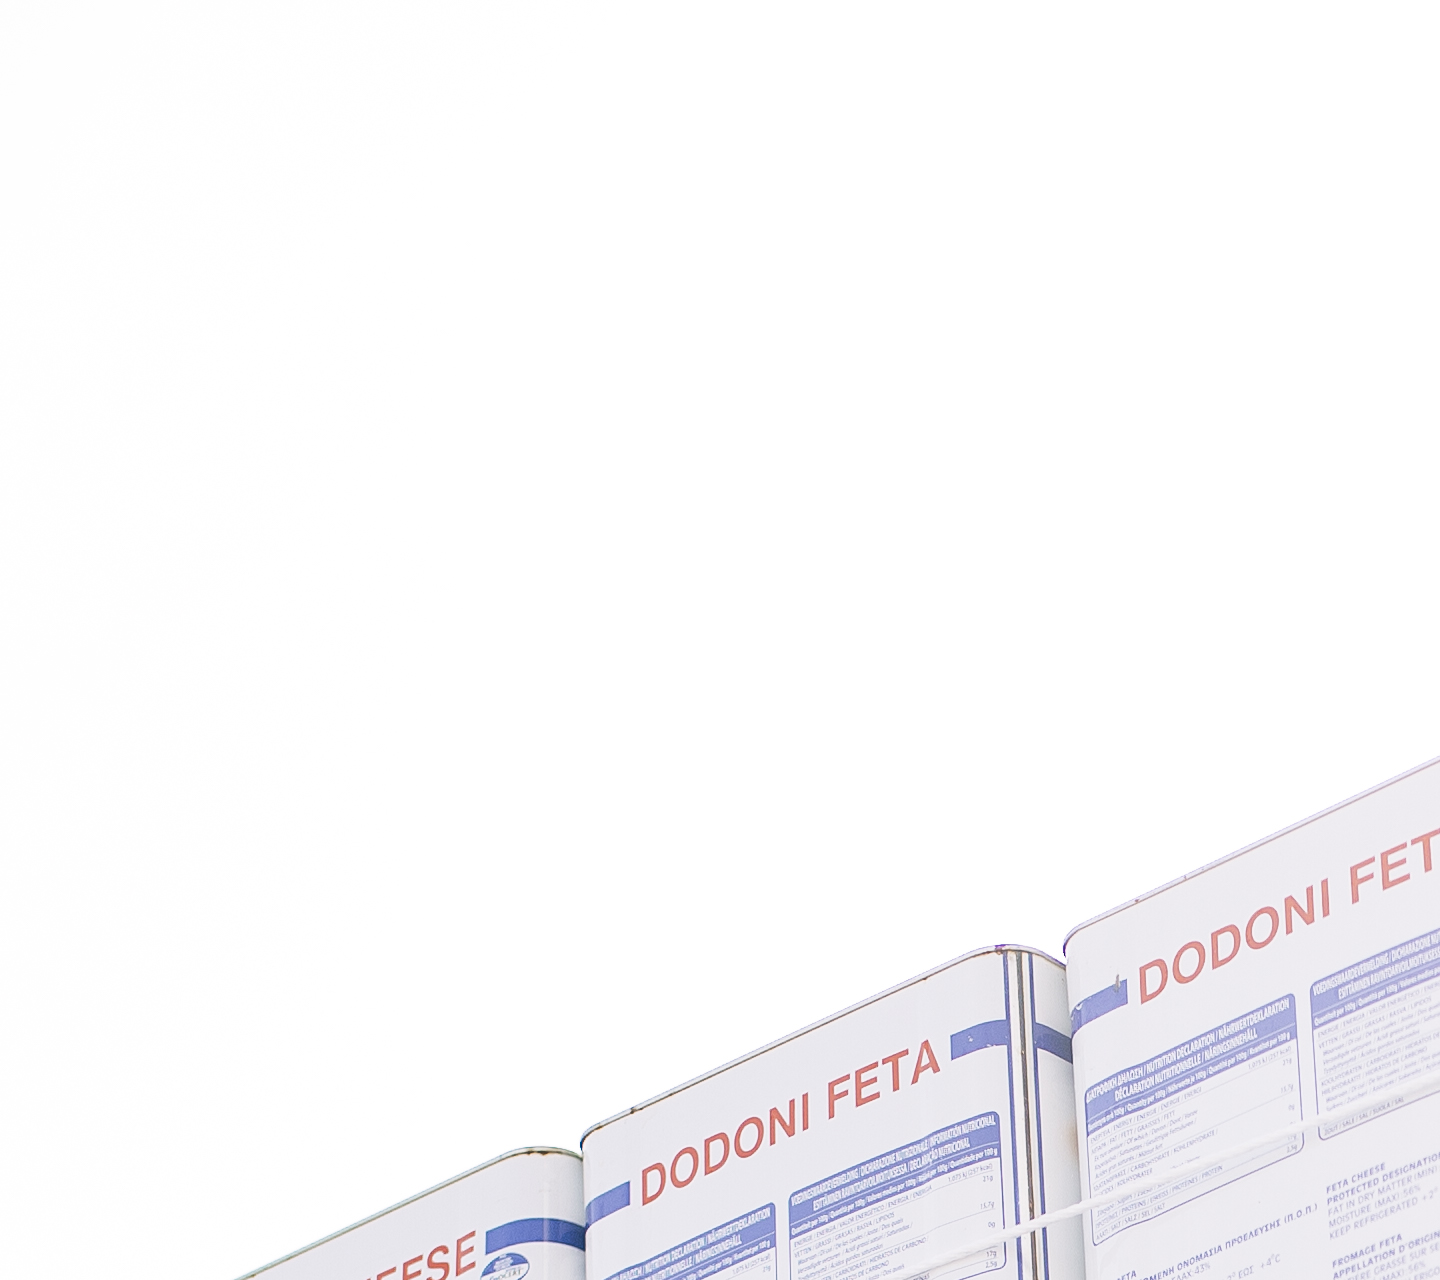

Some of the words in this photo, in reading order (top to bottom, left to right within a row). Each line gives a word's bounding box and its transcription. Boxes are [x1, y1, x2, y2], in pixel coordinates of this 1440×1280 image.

[1139, 878, 1330, 1005] DODONI
[642, 1092, 809, 1206] DODONI
[828, 1039, 940, 1120] FETA
